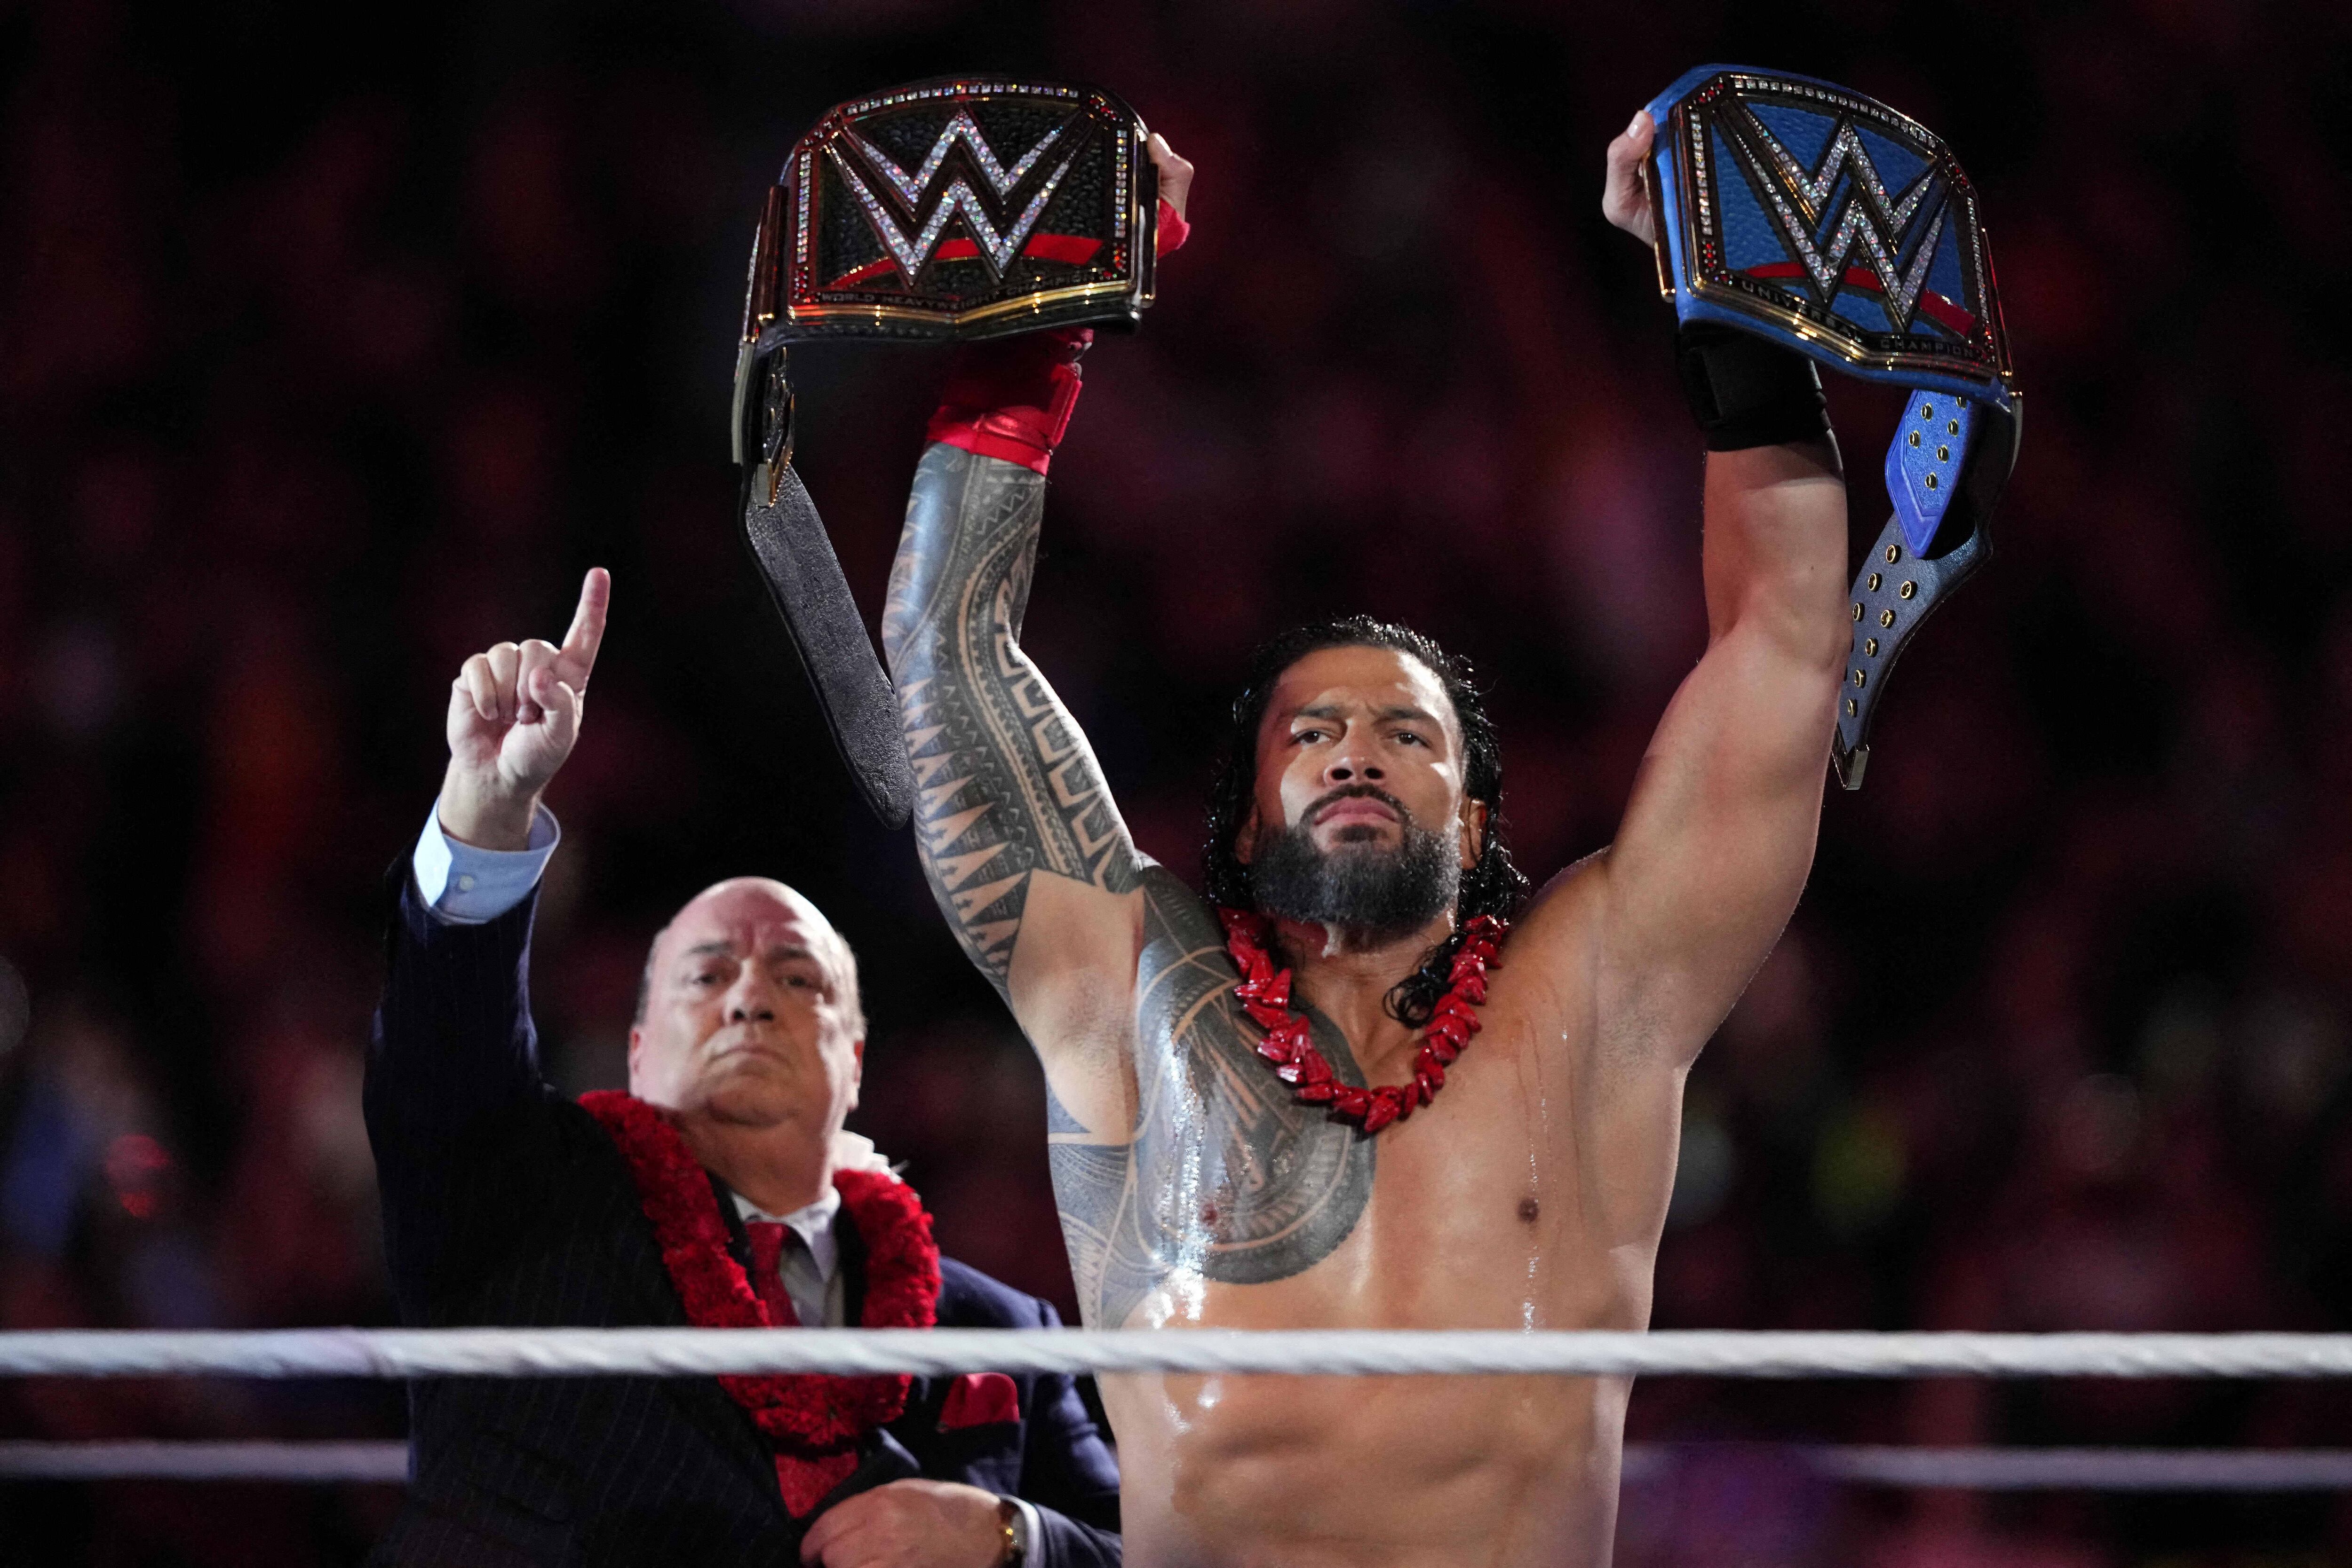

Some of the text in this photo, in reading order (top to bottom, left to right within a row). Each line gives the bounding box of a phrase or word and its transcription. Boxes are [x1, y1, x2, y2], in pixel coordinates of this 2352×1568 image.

[821, 292, 876, 303] WORLD
[1741, 279, 1975, 358] UNIVERSAL CHAMPION
